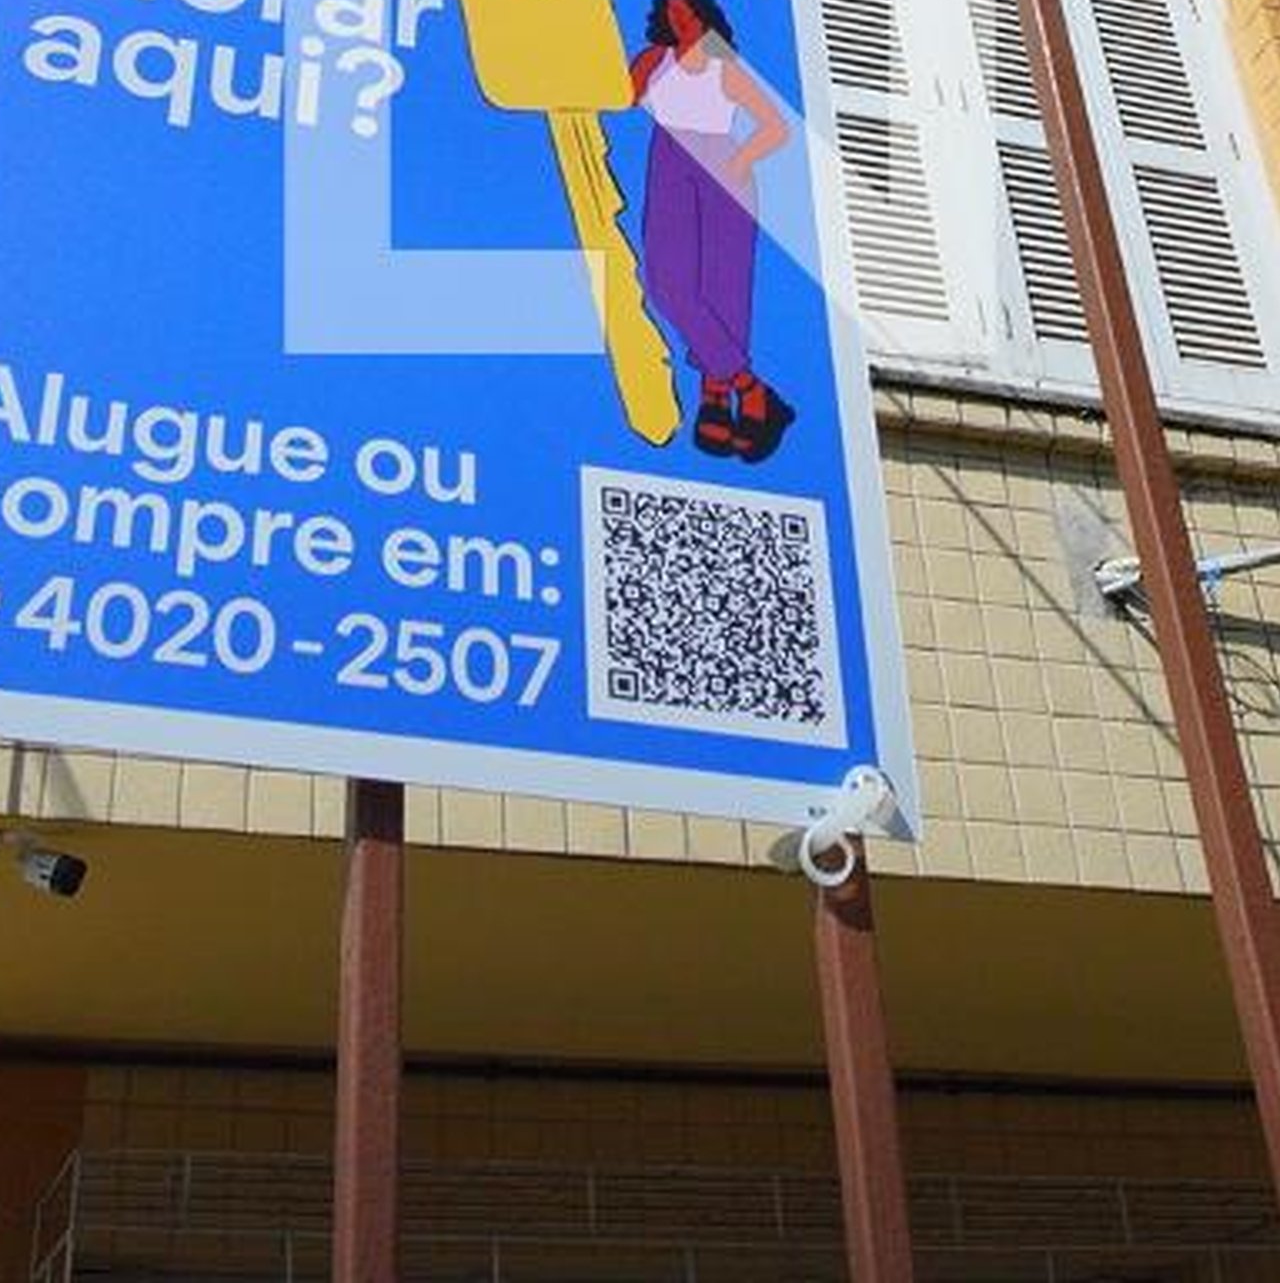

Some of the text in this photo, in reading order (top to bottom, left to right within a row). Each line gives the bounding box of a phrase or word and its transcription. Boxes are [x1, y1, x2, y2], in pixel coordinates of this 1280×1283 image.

[24, 15, 405, 137] aqui?
[355, 438, 477, 504] ou
[382, 526, 560, 606] em:
